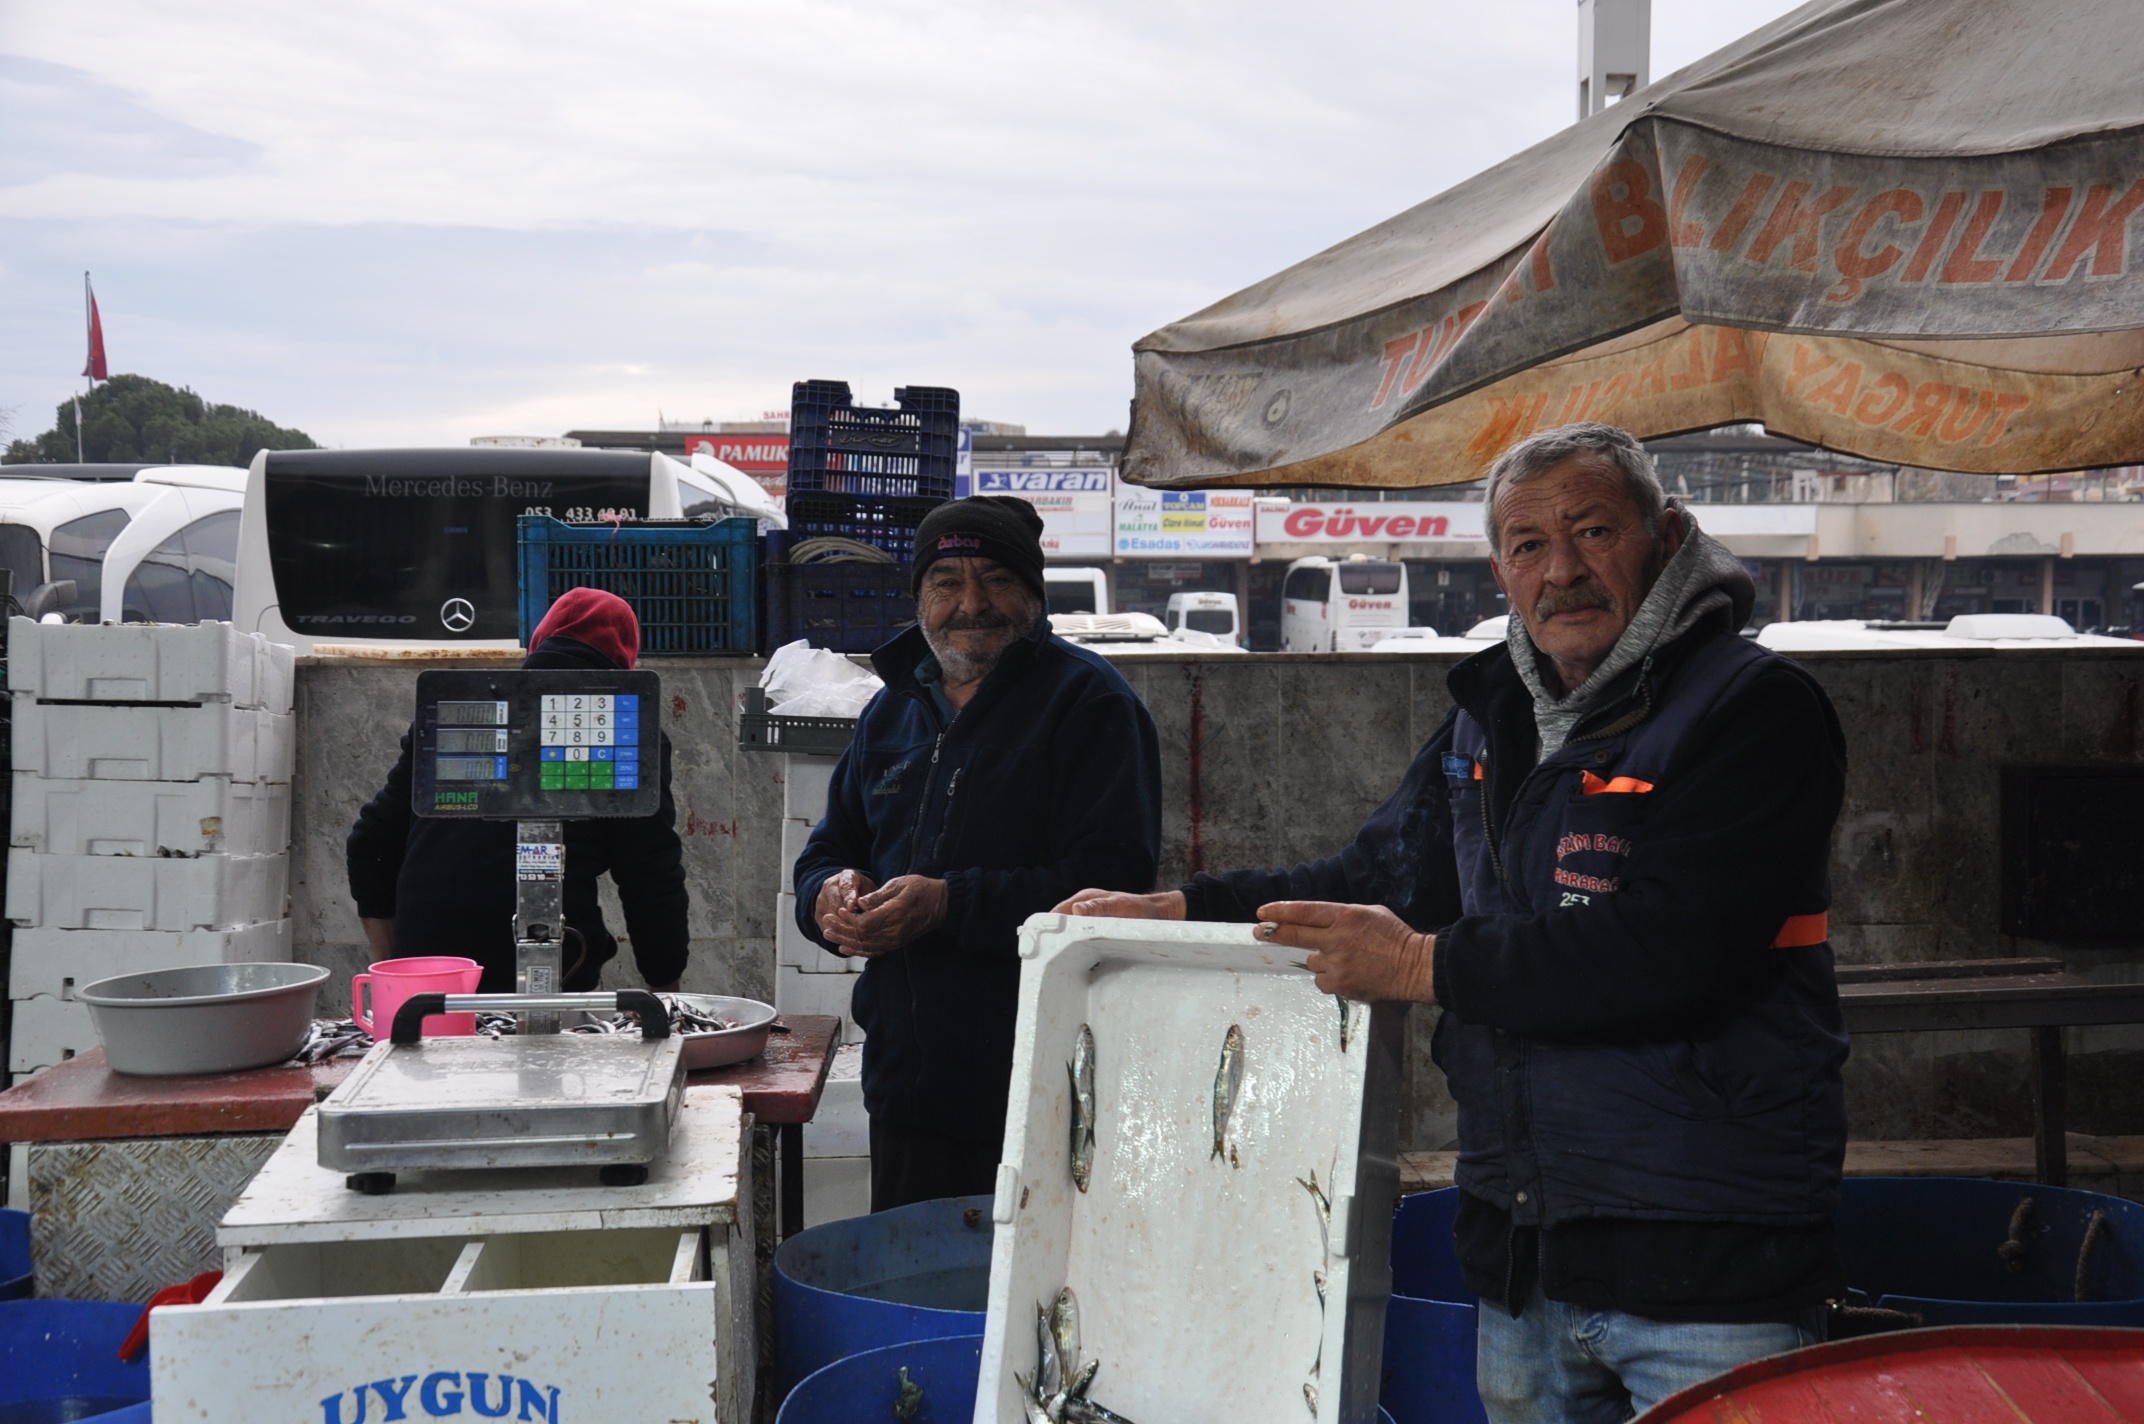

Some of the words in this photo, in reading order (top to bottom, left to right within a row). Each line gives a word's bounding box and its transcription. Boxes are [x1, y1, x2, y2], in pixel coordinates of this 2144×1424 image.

[364, 475, 553, 499] Mercedes-Benz
[1009, 472, 1106, 490] varan
[1209, 517, 1251, 528] Güven
[1284, 508, 1449, 537] Güven
[1349, 598, 1392, 609] Güven
[296, 615, 417, 624] TRAVEGO
[550, 698, 556, 710] 1
[574, 697, 582, 709] 2
[598, 697, 606, 709] 3
[549, 715, 557, 725] 4
[573, 714, 582, 727] 5
[597, 714, 606, 726] 6
[549, 731, 557, 743] 7
[573, 731, 581, 743] 8
[597, 731, 606, 743] 9
[573, 748, 581, 760] 0
[597, 749, 606, 759] C
[434, 792, 479, 803] HANA
[320, 1371, 561, 1424] UYGUN
